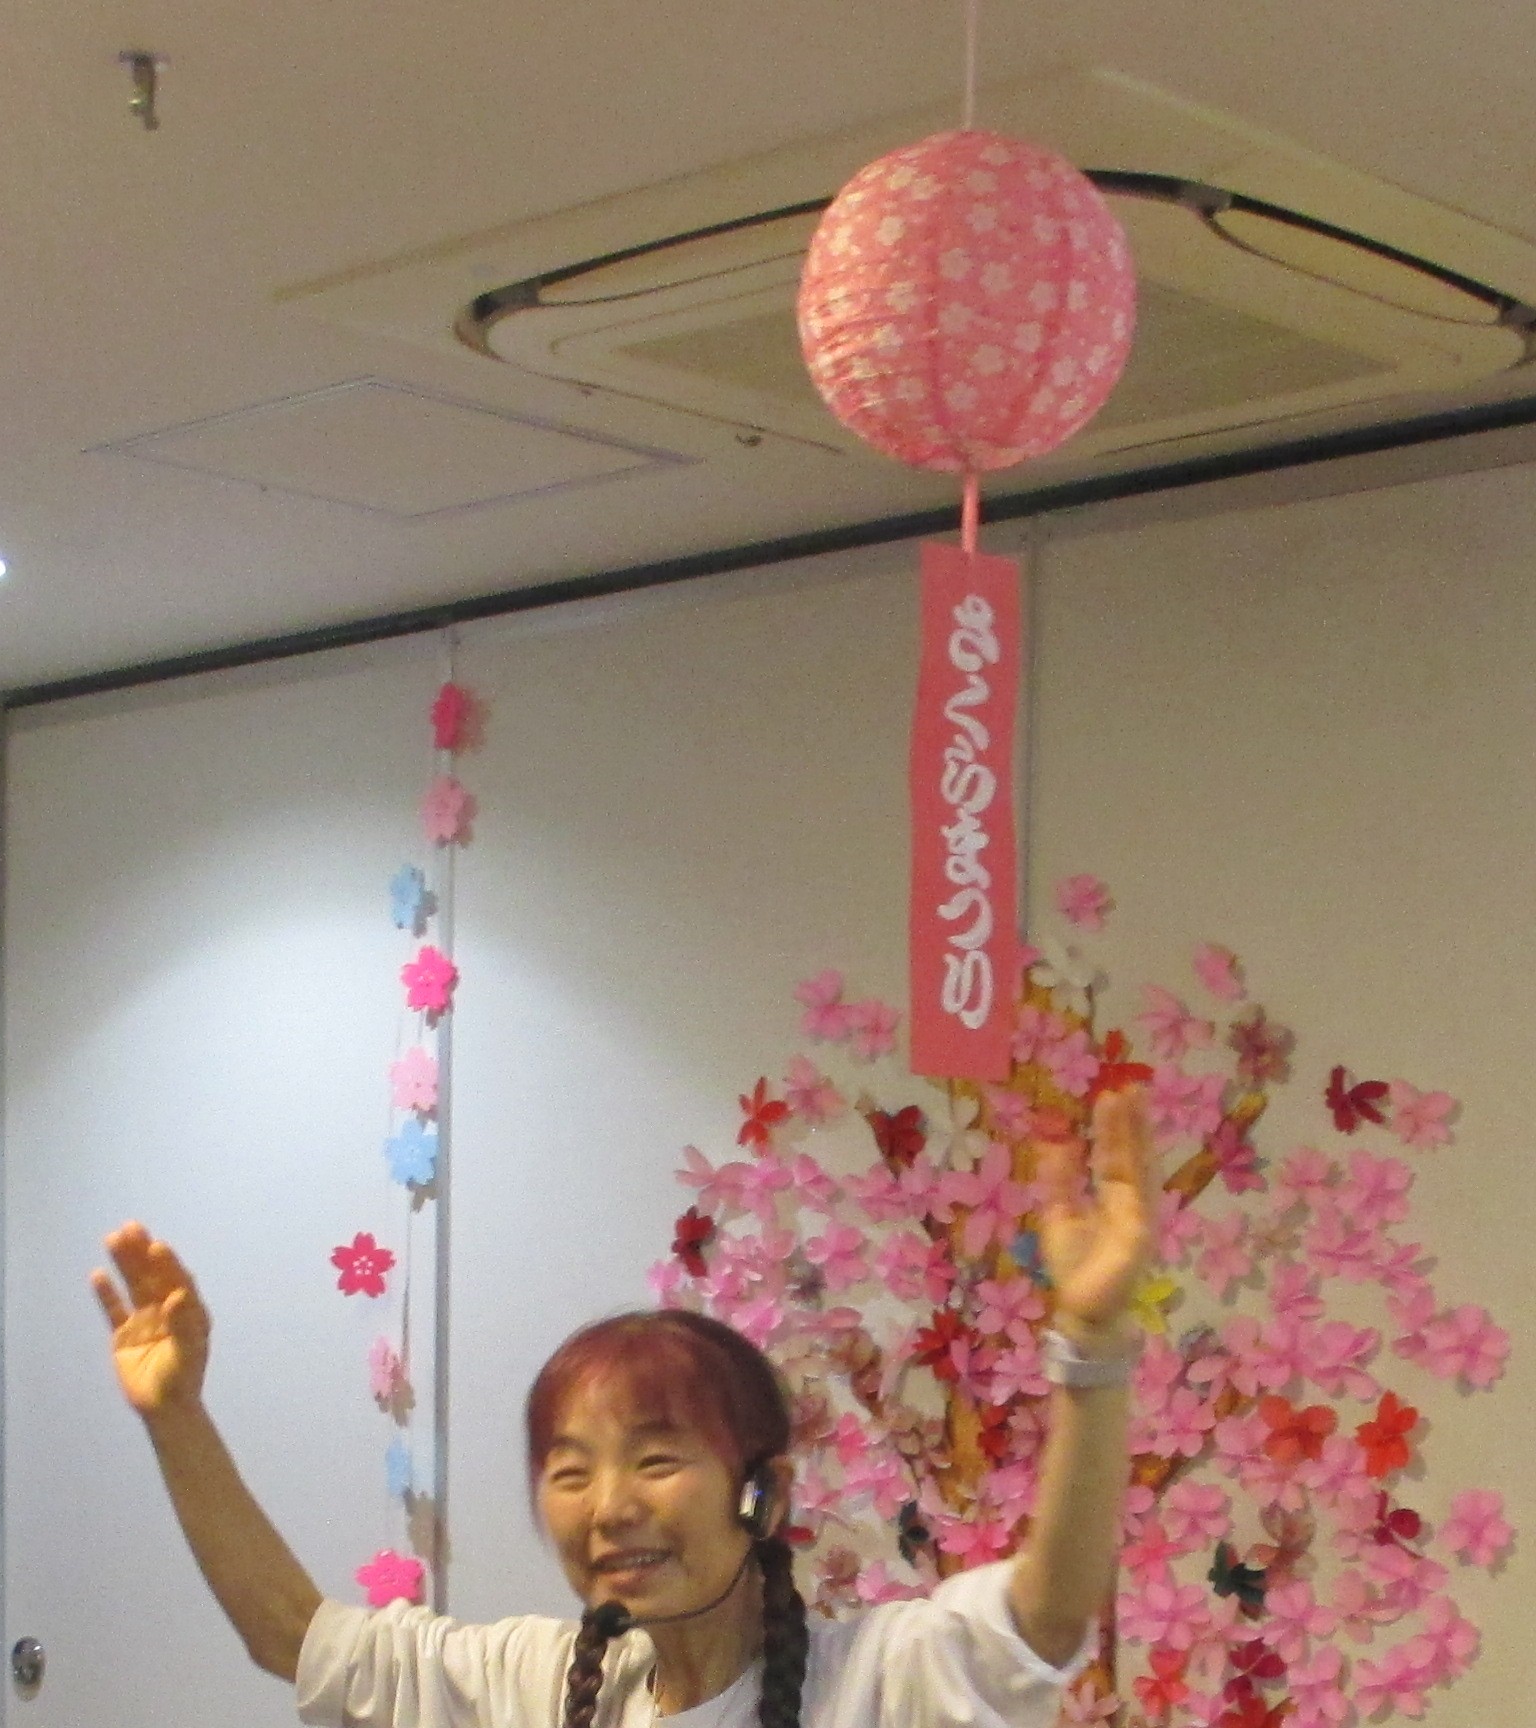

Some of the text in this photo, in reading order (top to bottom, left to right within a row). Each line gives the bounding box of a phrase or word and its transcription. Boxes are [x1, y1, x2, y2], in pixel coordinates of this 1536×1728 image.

[936, 595, 1000, 1030] さくらまつり
